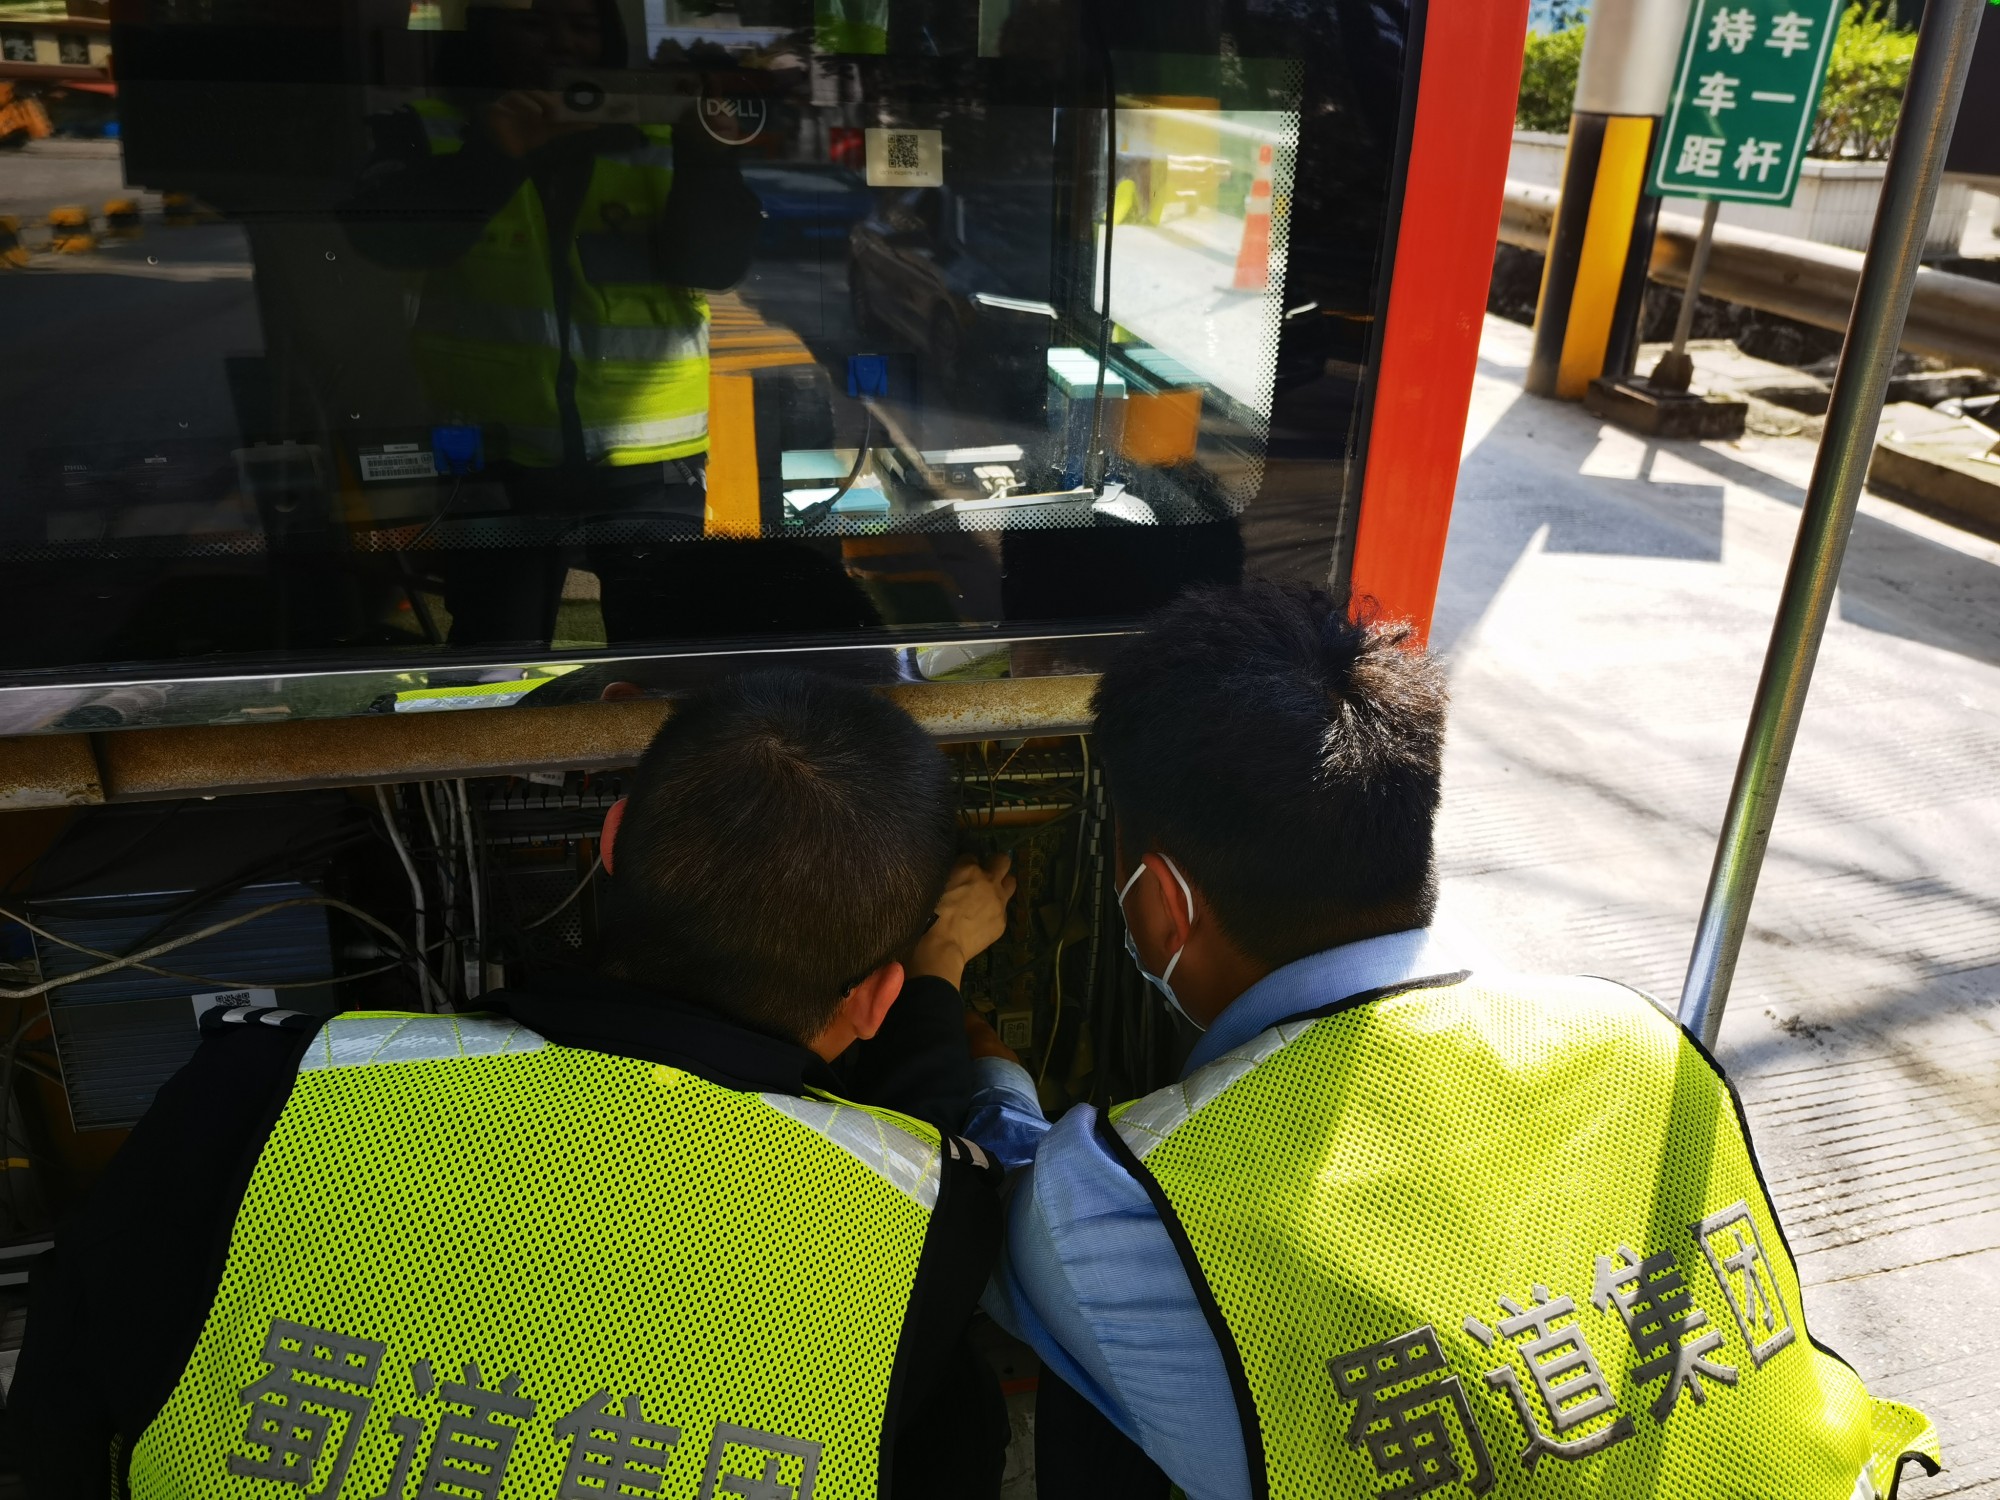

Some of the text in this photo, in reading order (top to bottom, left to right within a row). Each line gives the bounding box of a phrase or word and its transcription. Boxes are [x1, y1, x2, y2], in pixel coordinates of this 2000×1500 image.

[706, 98, 760, 118] DELL
[1326, 1199, 1796, 1500] 蜀道集团
